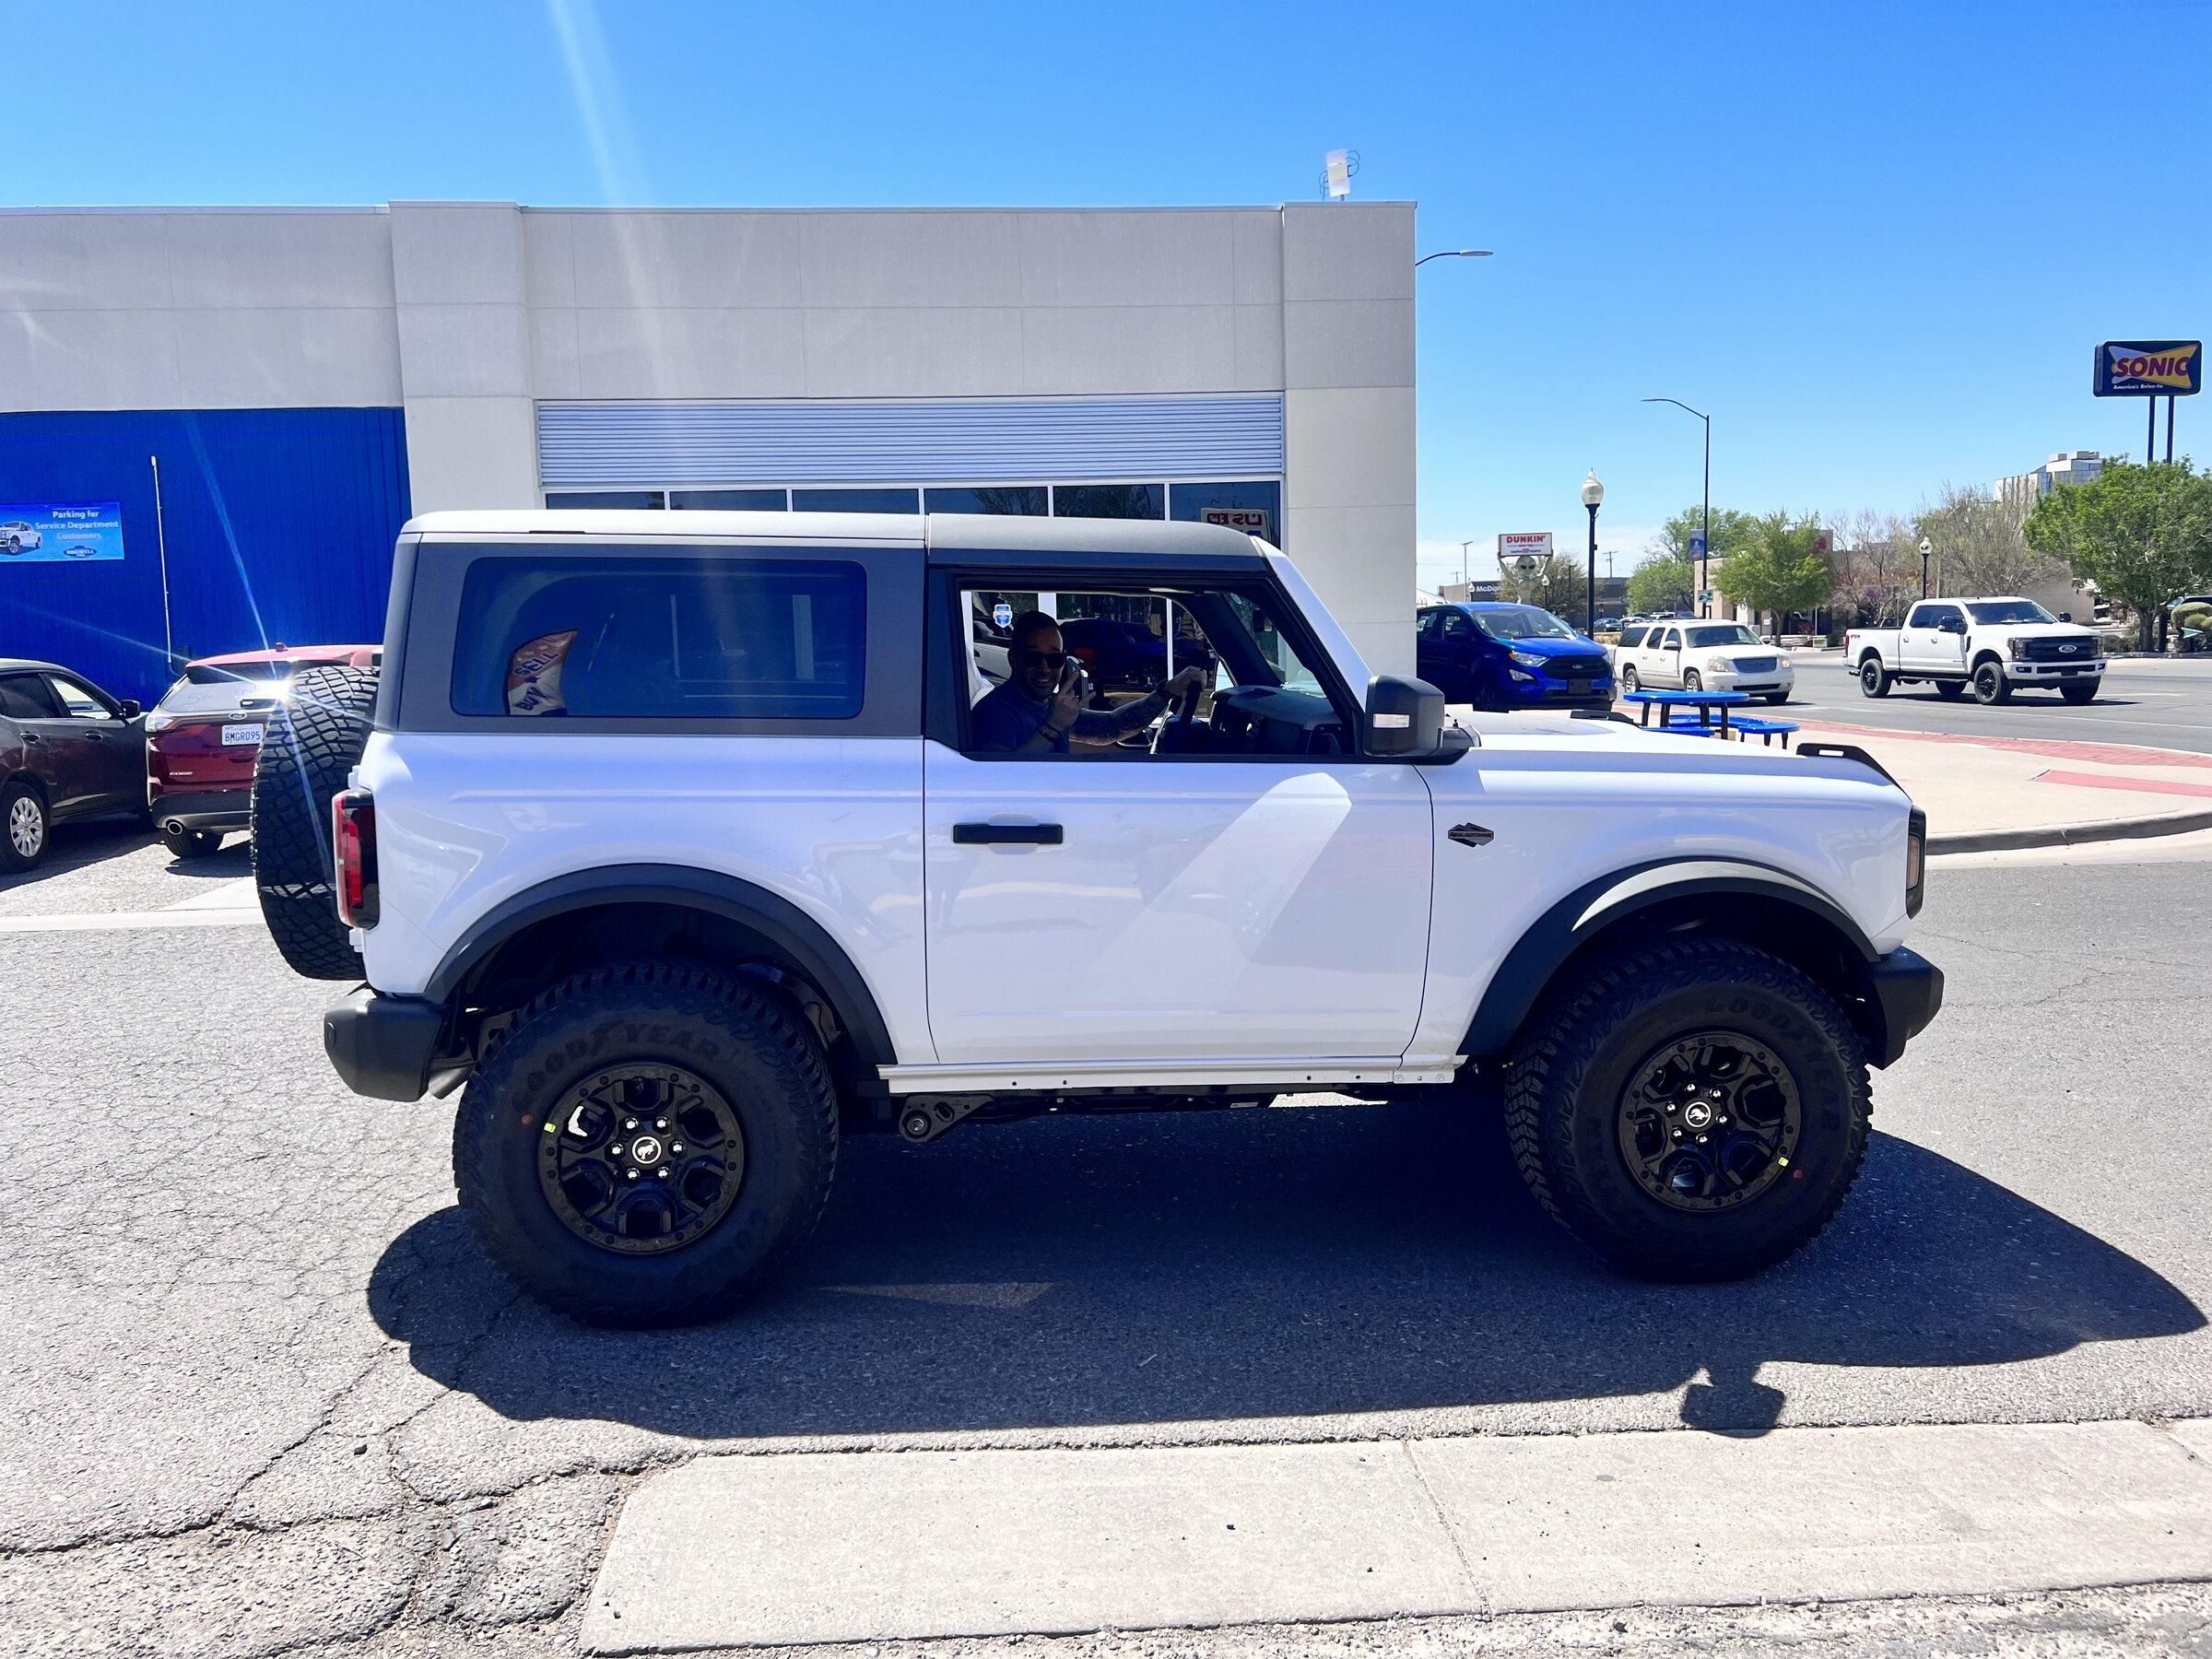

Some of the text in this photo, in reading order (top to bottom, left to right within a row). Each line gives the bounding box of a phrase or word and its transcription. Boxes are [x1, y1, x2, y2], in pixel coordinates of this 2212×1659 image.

[2113, 357, 2191, 378] SONIC
[53, 510, 100, 520] Parking for
[35, 520, 119, 531] Service Department
[56, 533, 102, 541] Customers
[1506, 535, 1546, 544] DUNKIN'
[513, 651, 559, 677] SELL
[515, 685, 549, 711] BUY
[225, 732, 261, 743] 8MGR095
